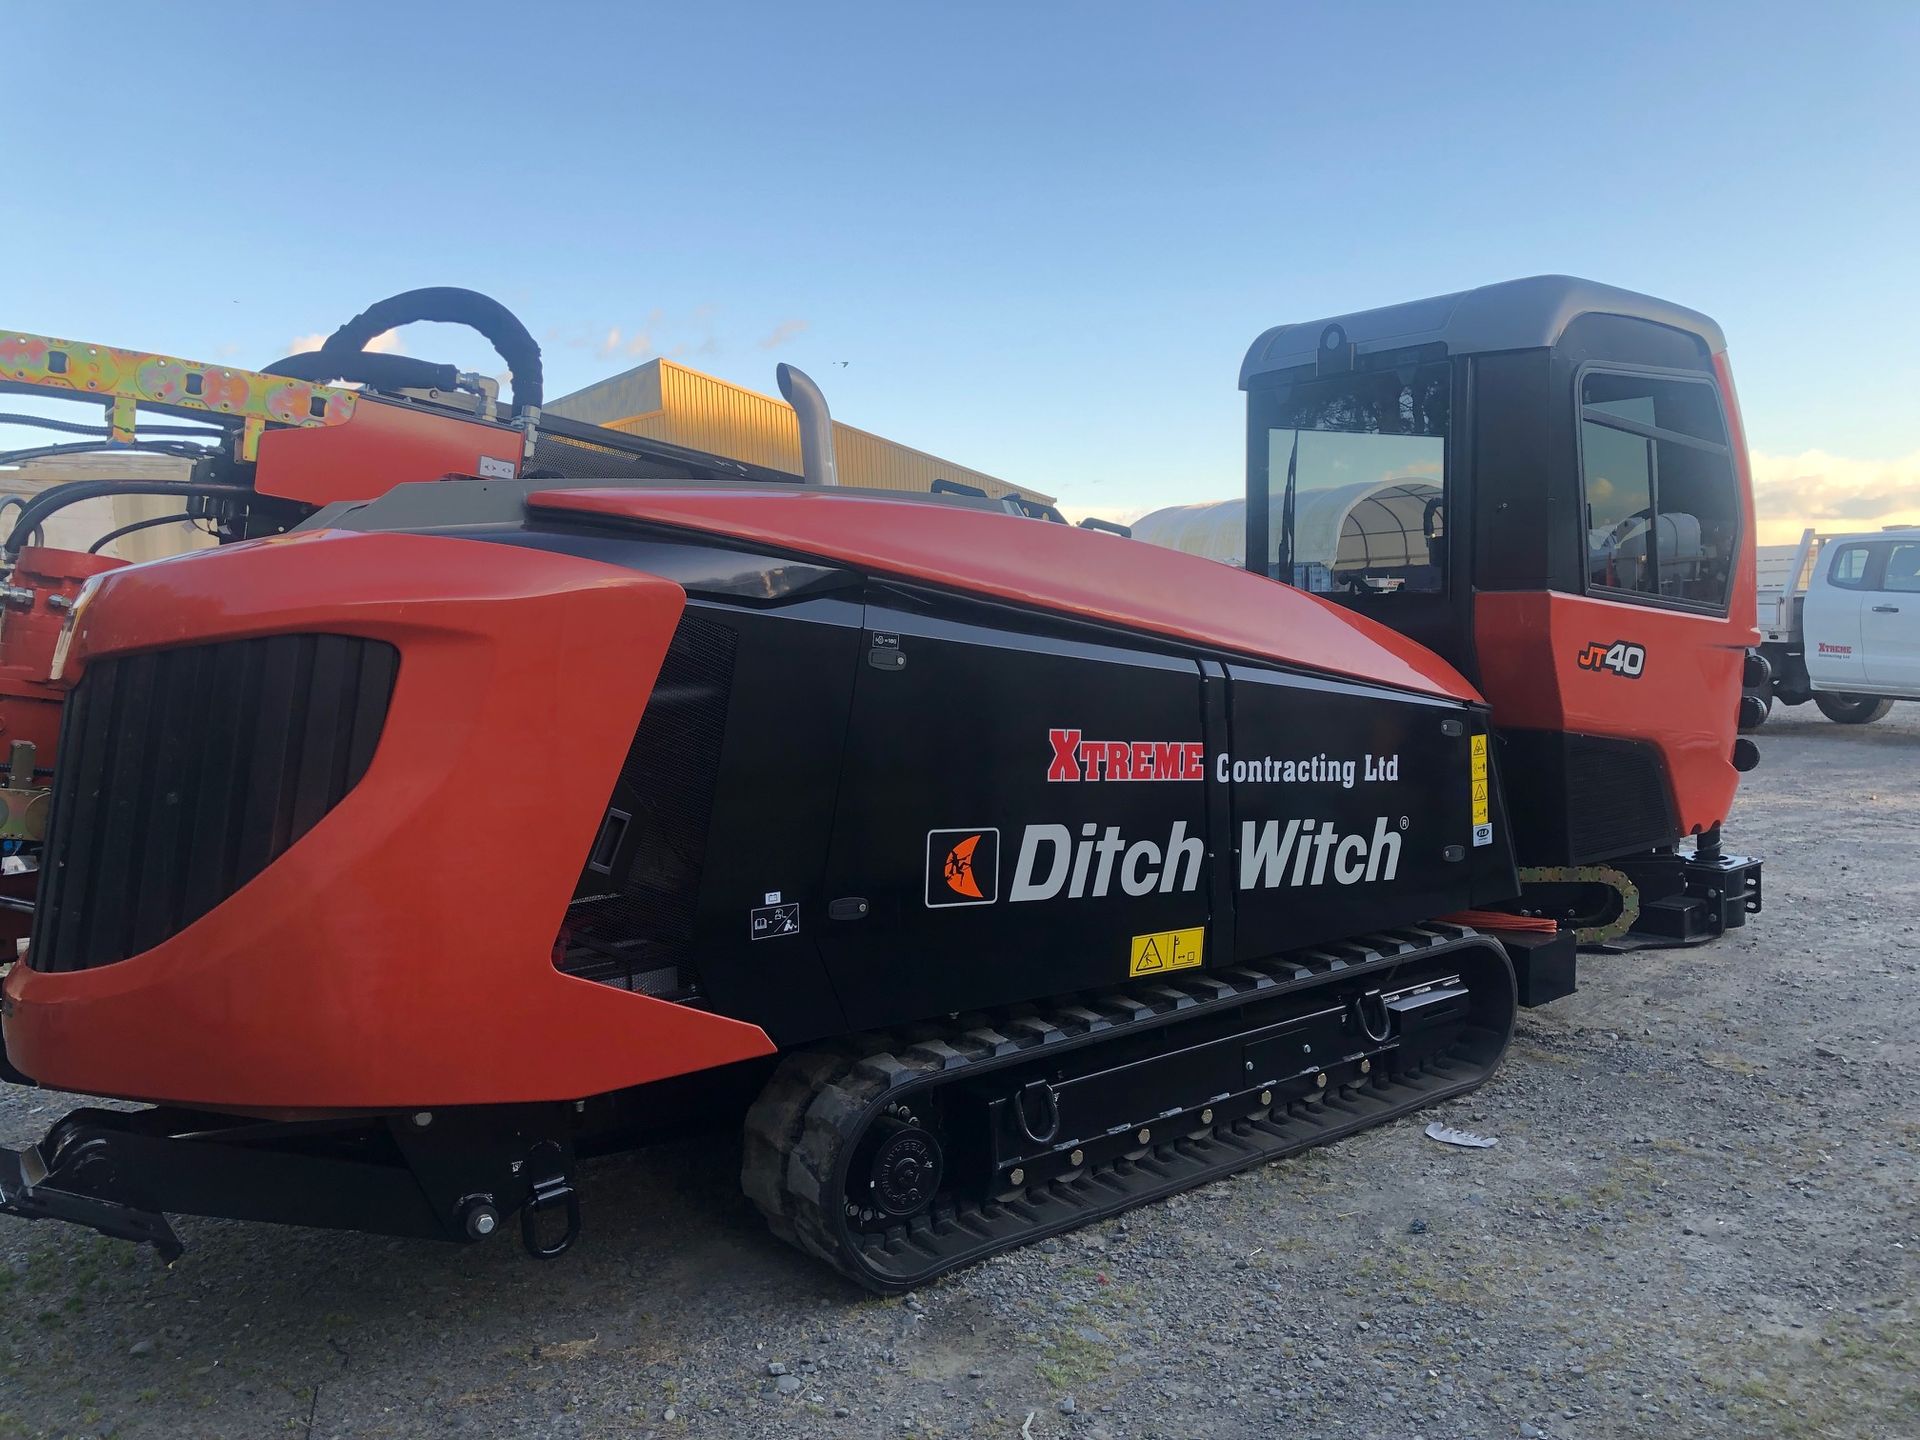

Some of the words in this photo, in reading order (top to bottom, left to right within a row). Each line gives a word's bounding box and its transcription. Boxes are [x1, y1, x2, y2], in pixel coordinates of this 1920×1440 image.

[1579, 643, 1645, 676] JT40
[1818, 642, 1852, 653] XTREME
[1047, 728, 1204, 782] XTREME
[1216, 752, 1356, 789] Contracting
[1364, 754, 1399, 782] Ltd
[1009, 820, 1205, 902] Ditch
